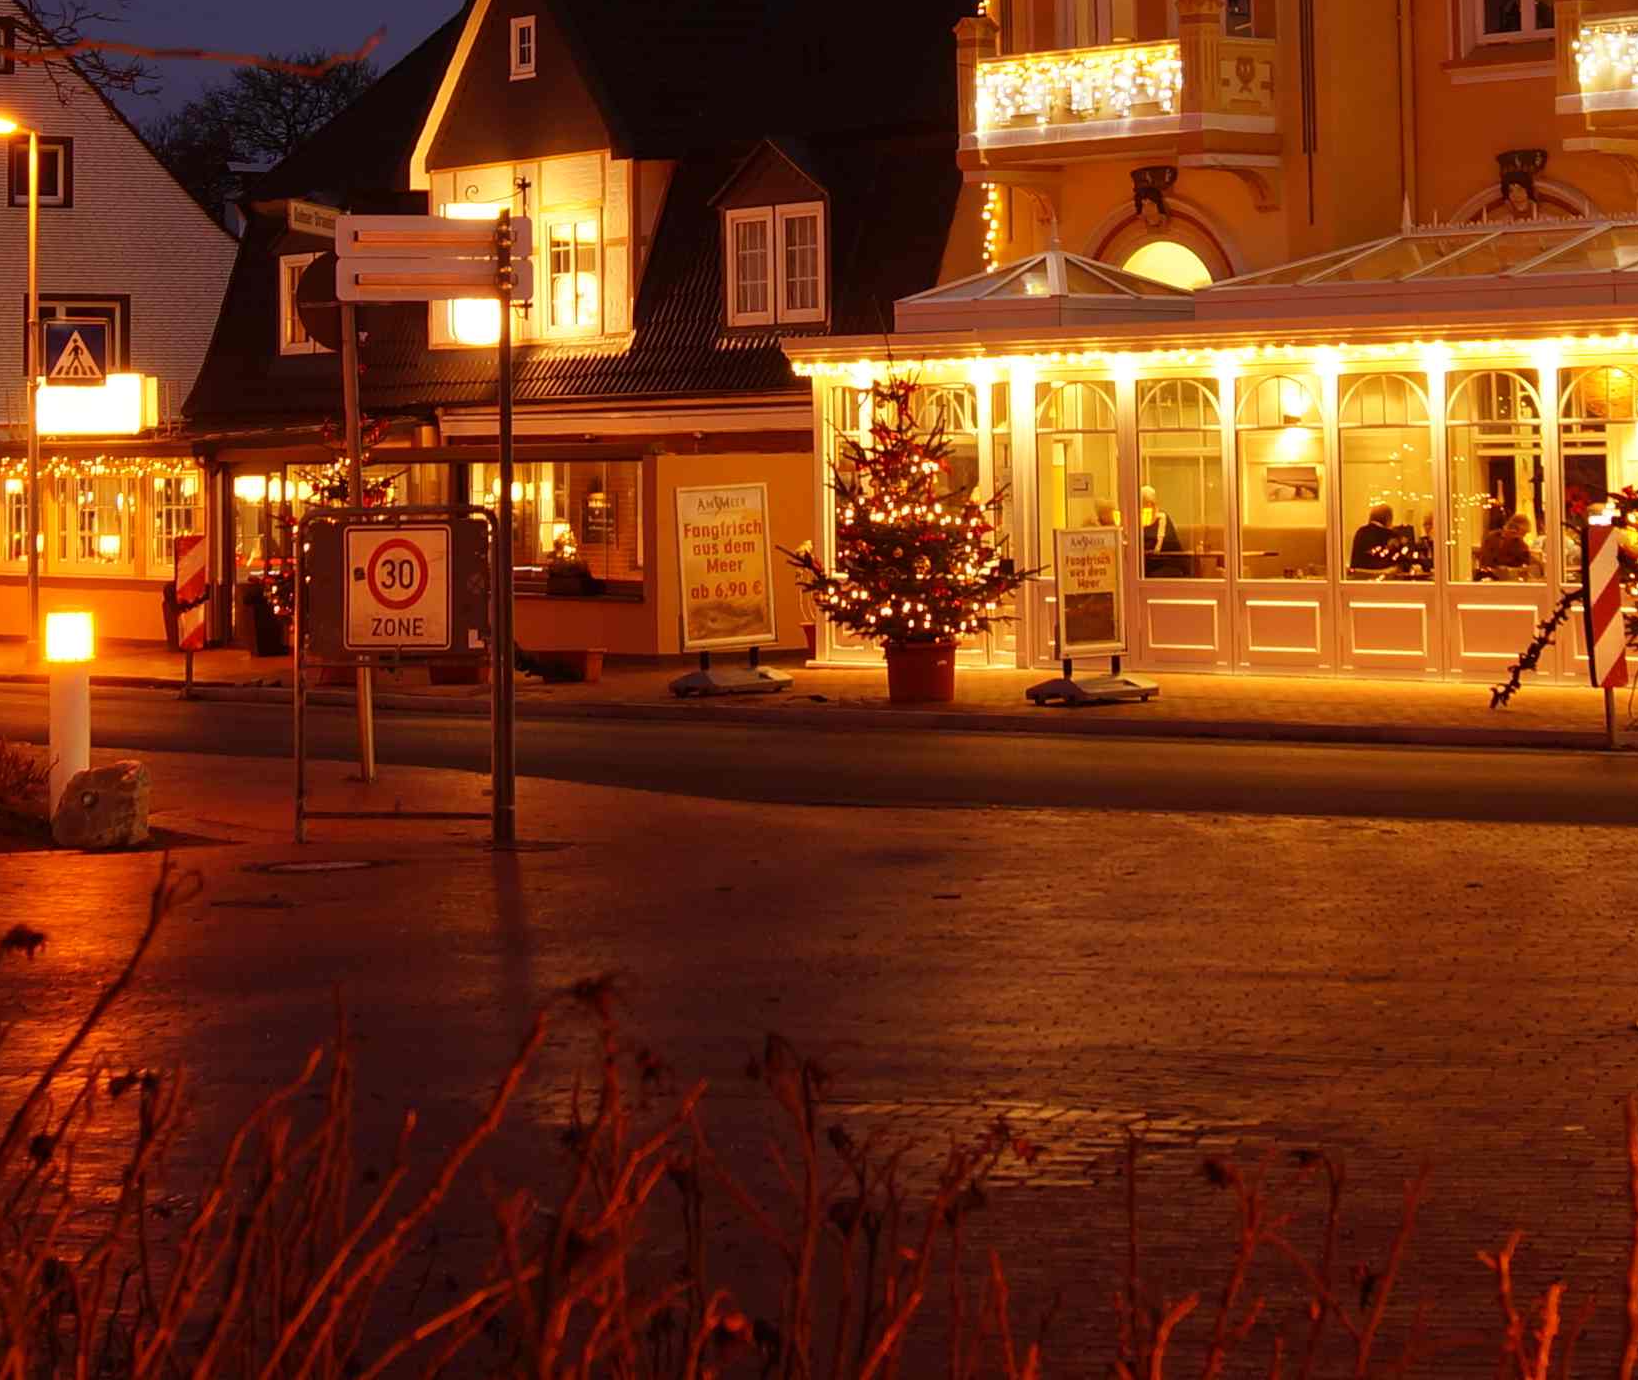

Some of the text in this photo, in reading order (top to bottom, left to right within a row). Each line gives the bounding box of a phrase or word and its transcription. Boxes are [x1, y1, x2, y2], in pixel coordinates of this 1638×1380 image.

[684, 519, 763, 540] Fangfrisch
[693, 537, 756, 556] aus dem
[380, 559, 414, 589] 30
[706, 558, 744, 573] Meer
[691, 580, 763, 599] ab 6,90 €
[371, 617, 424, 637] ZONE
